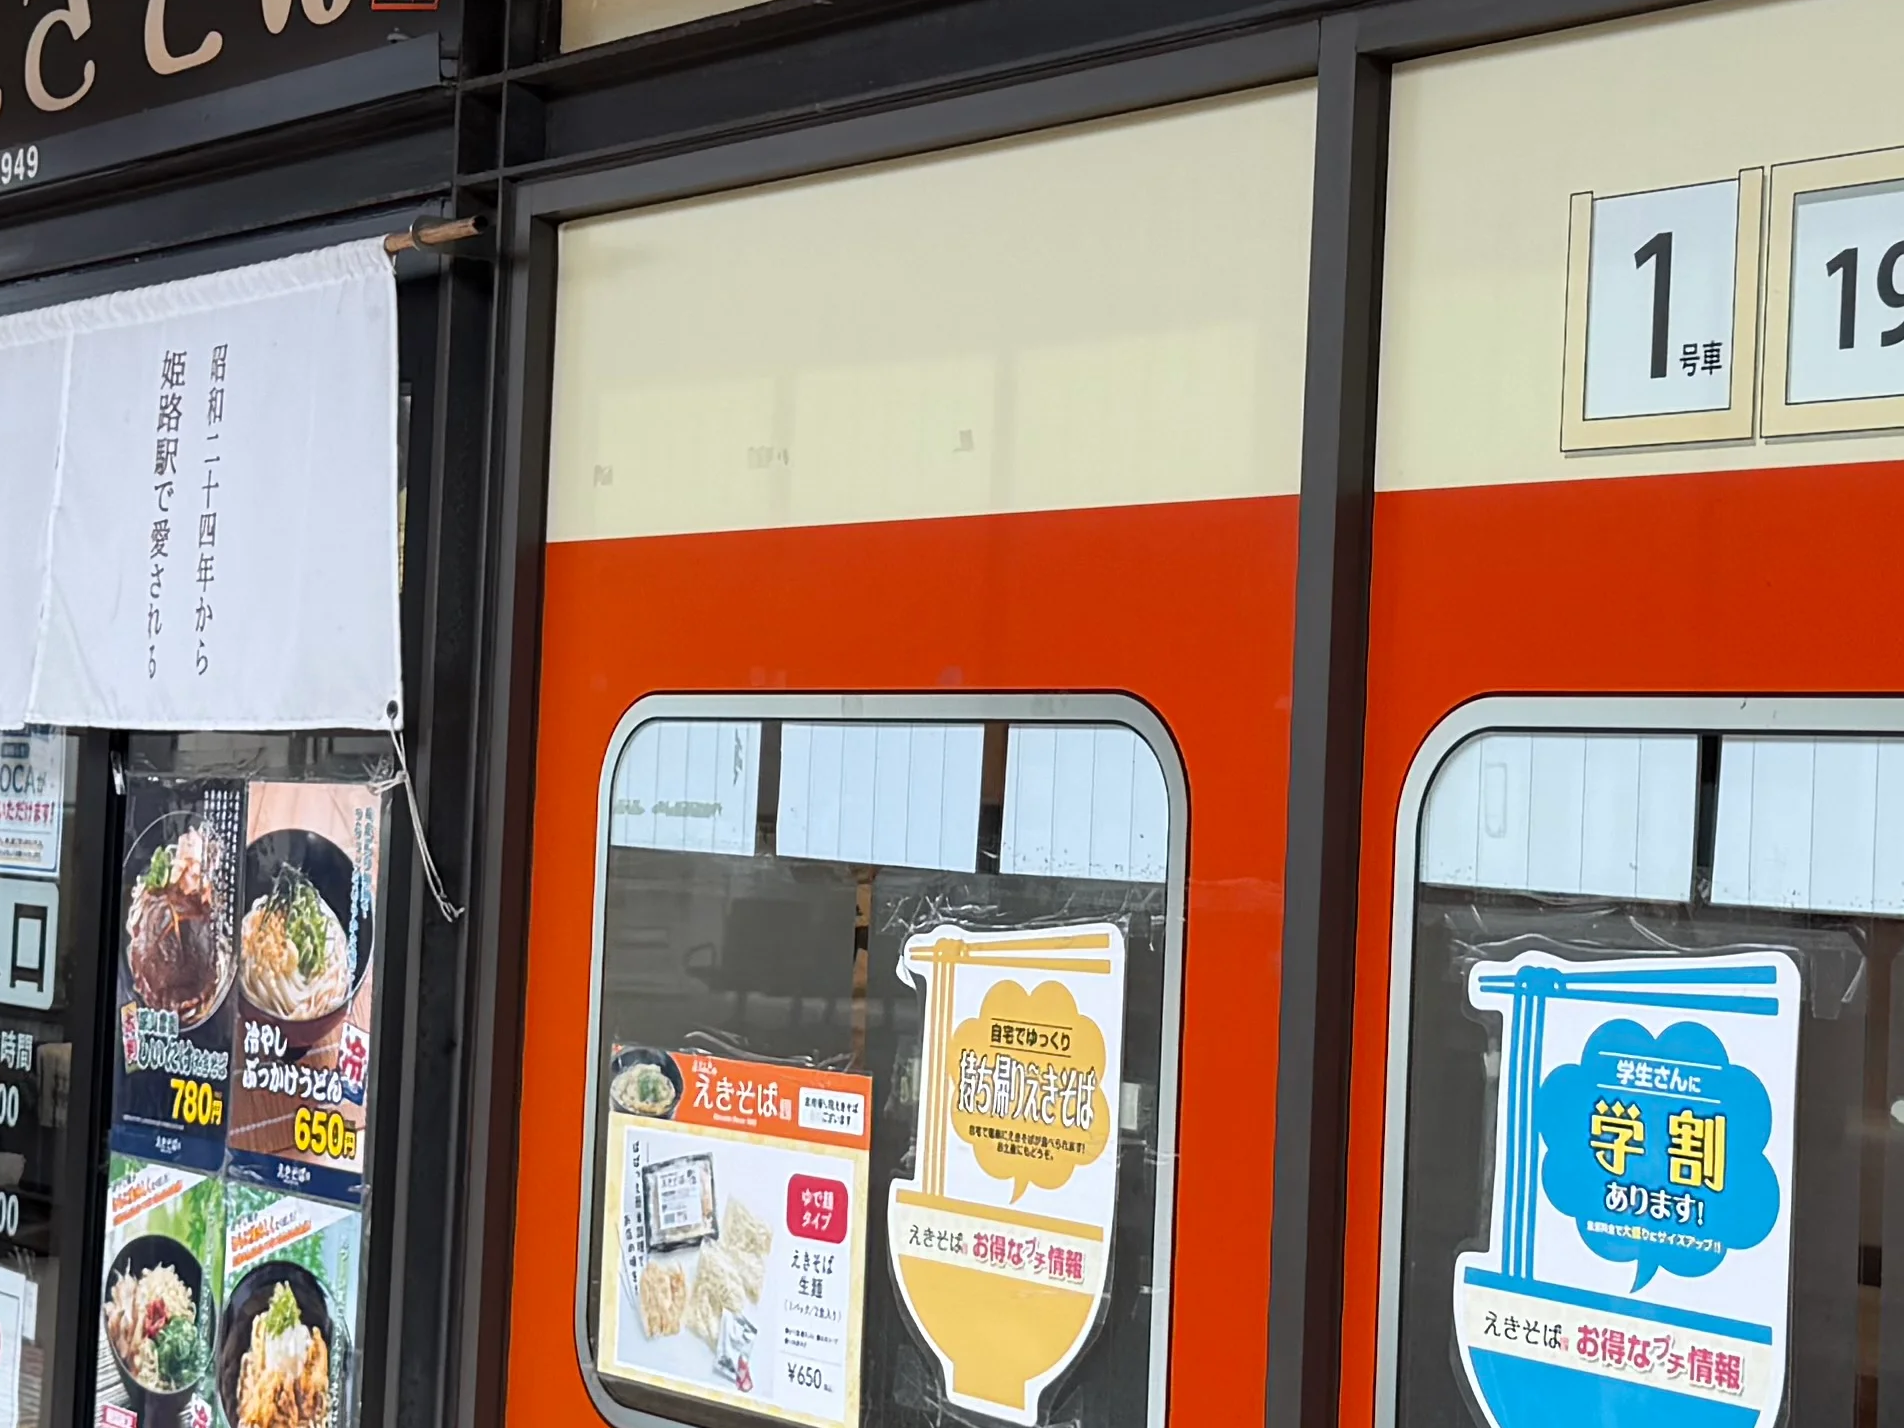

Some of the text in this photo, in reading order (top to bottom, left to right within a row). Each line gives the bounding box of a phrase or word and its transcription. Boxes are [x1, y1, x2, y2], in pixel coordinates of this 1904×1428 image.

[1632, 231, 1723, 380] 1 号車
[146, 350, 186, 680] 姫路駅で愛される
[193, 343, 228, 677] 昭和二十四年から
[244, 1021, 288, 1057] 冷やし
[990, 1022, 1072, 1052] 自宅でゆっくり
[242, 1058, 342, 1103] ぶっかけうどん
[693, 1074, 778, 1117] えきそば
[957, 1049, 1096, 1130] 持ち帰りえきそば
[1617, 1059, 1701, 1094] 学生さんに
[170, 1078, 223, 1126] 780円
[294, 1107, 356, 1159] 650円
[1590, 1099, 1726, 1192] 学割
[802, 1189, 834, 1210] ゆで麺
[802, 1212, 832, 1231] タイプ
[1605, 1181, 1705, 1226] あります!
[791, 1250, 834, 1274] えきそば
[909, 1222, 1084, 1280] えきそば お得なプチ情報
[798, 1276, 823, 1298] 生麺
[1484, 1311, 1742, 1391] えきそば お得なプチ情報
[788, 1362, 822, 1390] ¥650
